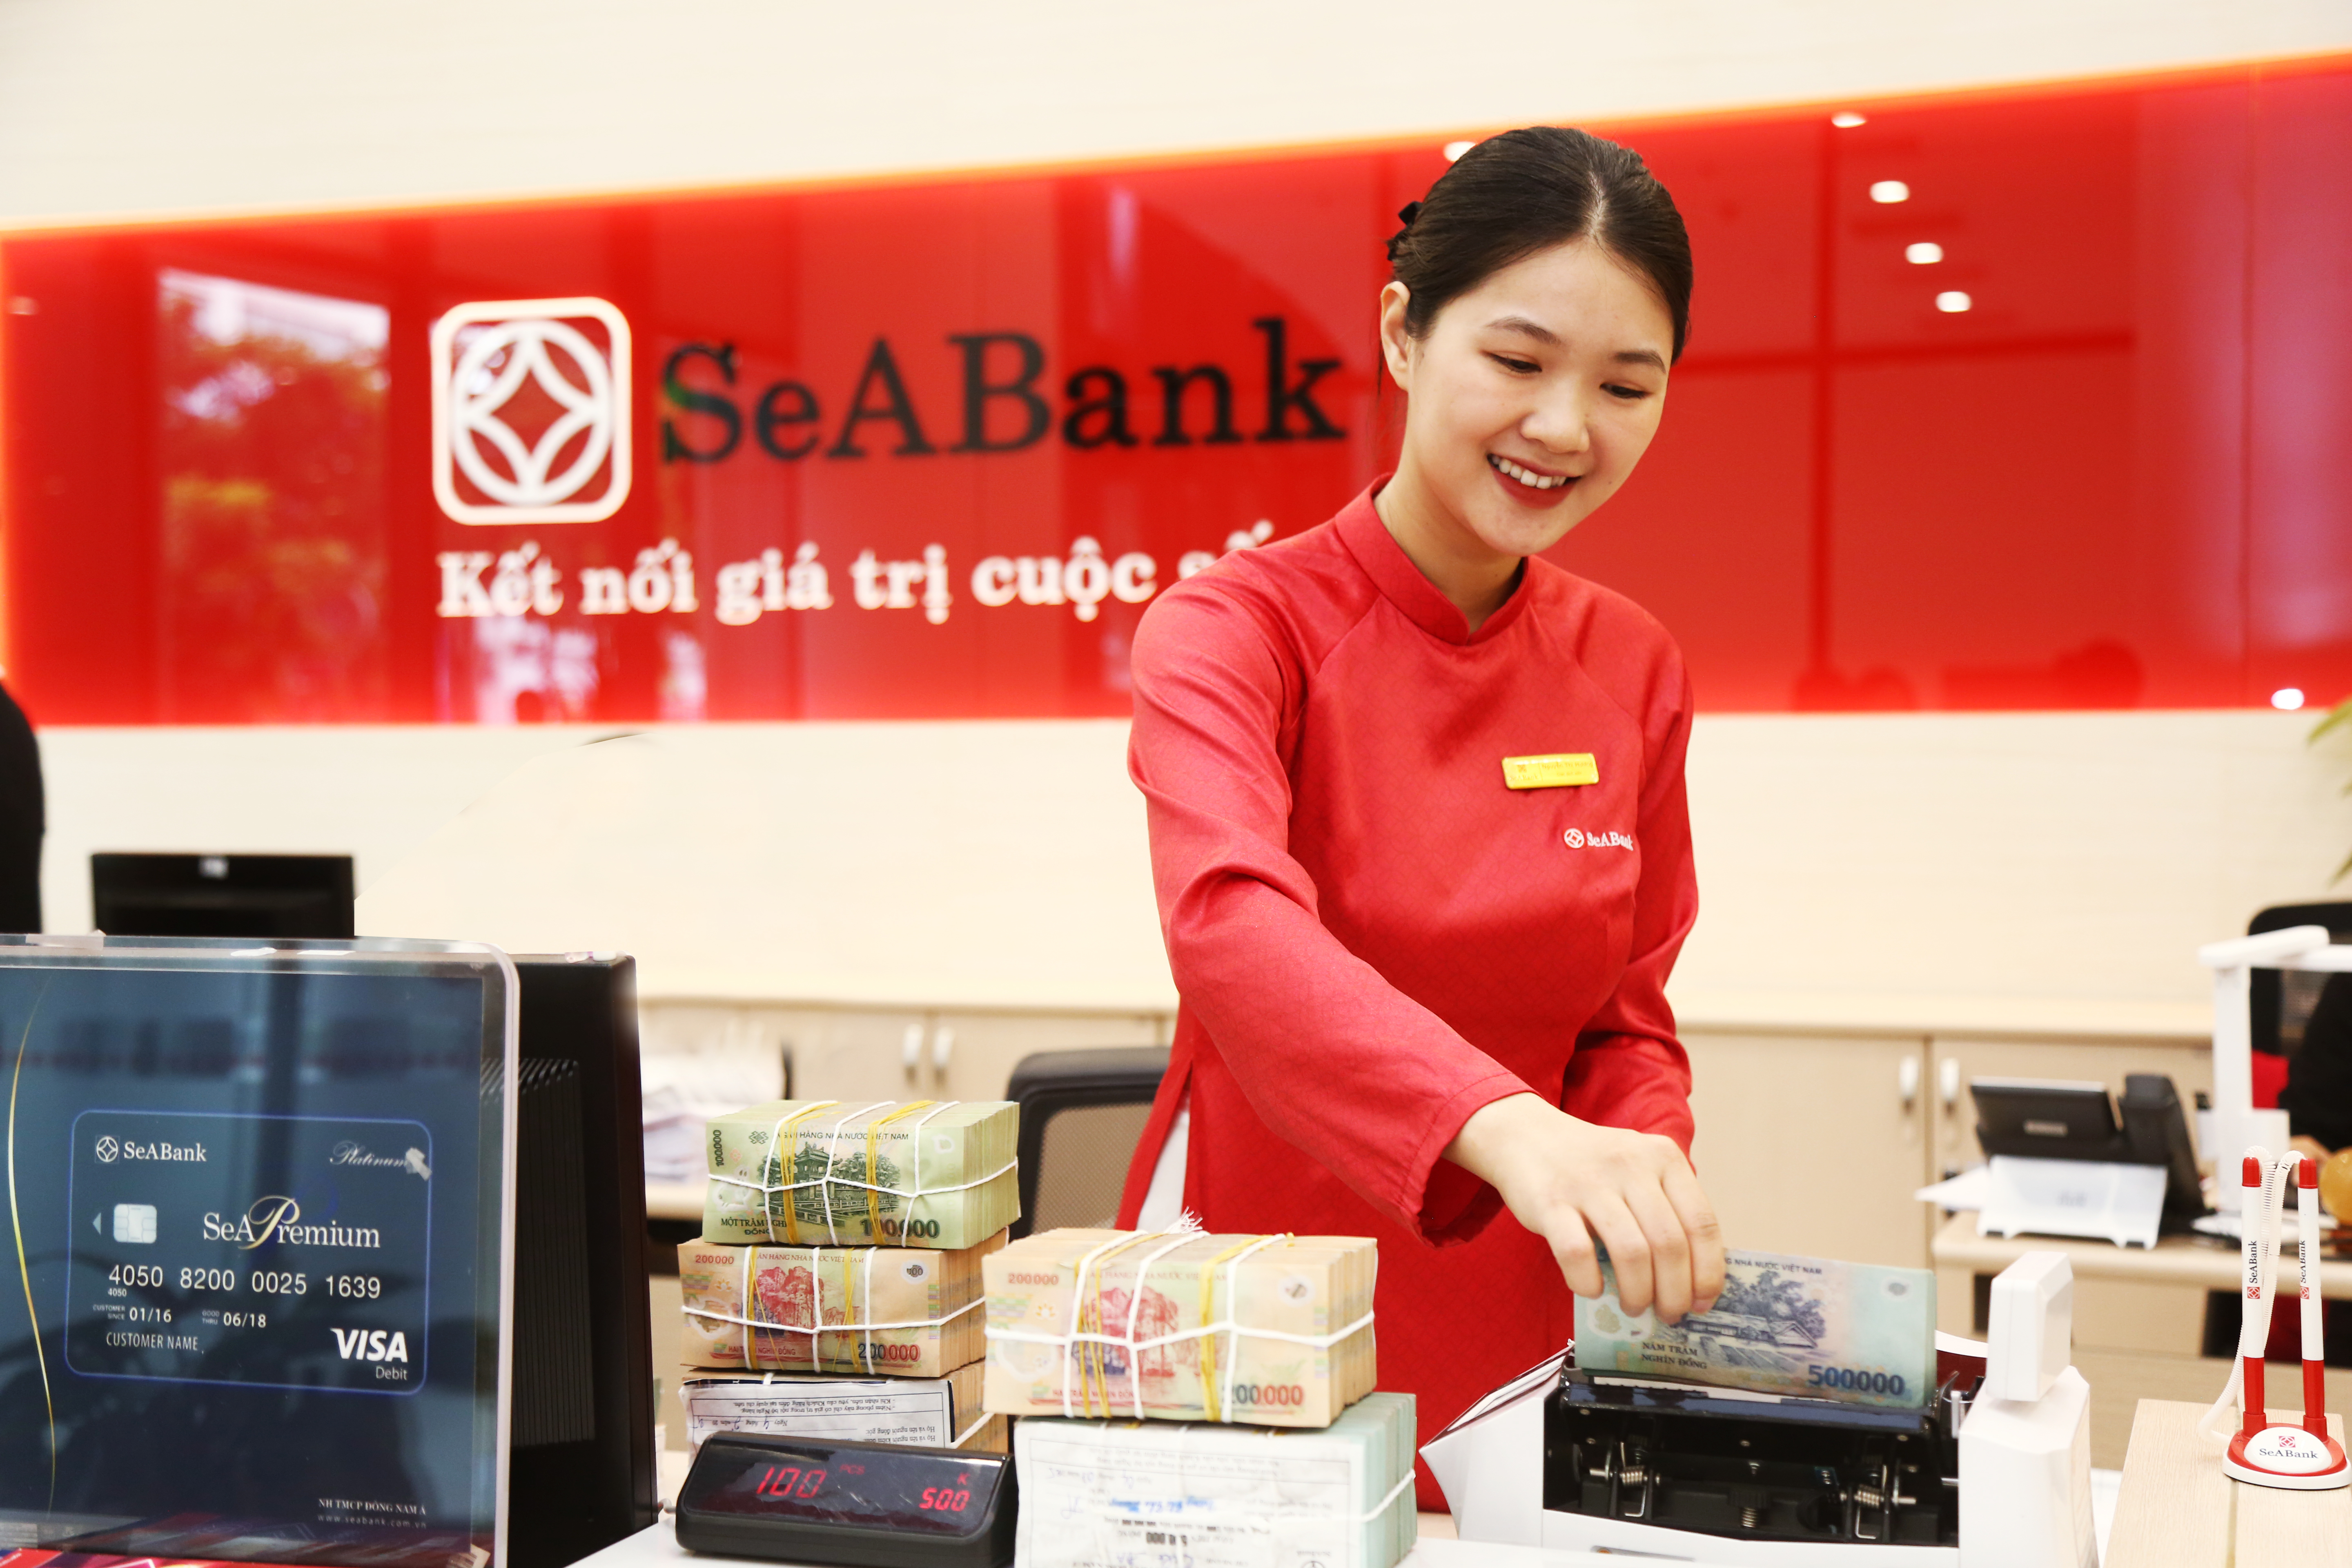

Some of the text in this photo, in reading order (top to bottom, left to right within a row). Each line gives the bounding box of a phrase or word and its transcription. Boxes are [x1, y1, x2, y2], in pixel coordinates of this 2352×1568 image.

[659, 317, 1348, 464] SeABank
[437, 541, 563, 619] Kết
[580, 537, 699, 615] nối
[716, 541, 833, 626] giá
[853, 545, 953, 624] trị
[971, 536, 1156, 621] cuộc
[1586, 831, 1634, 851] SeABank
[800, 1130, 823, 1138] HÀNG
[123, 1141, 207, 1162] SeABank
[329, 1140, 409, 1167] Platinum
[713, 1129, 724, 1167] 100000
[721, 1217, 738, 1227] MỘT
[739, 1217, 764, 1227] TRĂM
[860, 1218, 940, 1239] 10000
[695, 1255, 734, 1265] 200000
[769, 1252, 790, 1261] HÀNG
[2248, 1240, 2258, 1284] SeABank
[109, 1264, 381, 1299] 4050 8200 0025 1639
[1008, 1273, 1059, 1285] 200000
[107, 1288, 127, 1297] 4050
[129, 1306, 172, 1323] 01/16
[202, 1310, 220, 1318] GOOD
[202, 1317, 218, 1325] THRU
[223, 1311, 267, 1328] 06/18
[106, 1332, 198, 1351] CUSTOMER NAME
[329, 1327, 408, 1363] VISA
[858, 1343, 921, 1362] 200000
[1642, 1353, 1707, 1369] NGHÌN ĐỒNG
[375, 1365, 408, 1381] Debit
[1808, 1364, 1905, 1395] 500000
[892, 1426, 908, 1435] người
[2259, 1448, 2319, 1459] SeABank
[756, 1463, 866, 1499] 100 PCS
[957, 1472, 971, 1486] K
[318, 1498, 333, 1508] NH
[335, 1499, 363, 1510] TMCP
[395, 1503, 417, 1515] NAM
[919, 1487, 971, 1512] 500
[317, 1514, 427, 1529] www.seabank.com.vn
